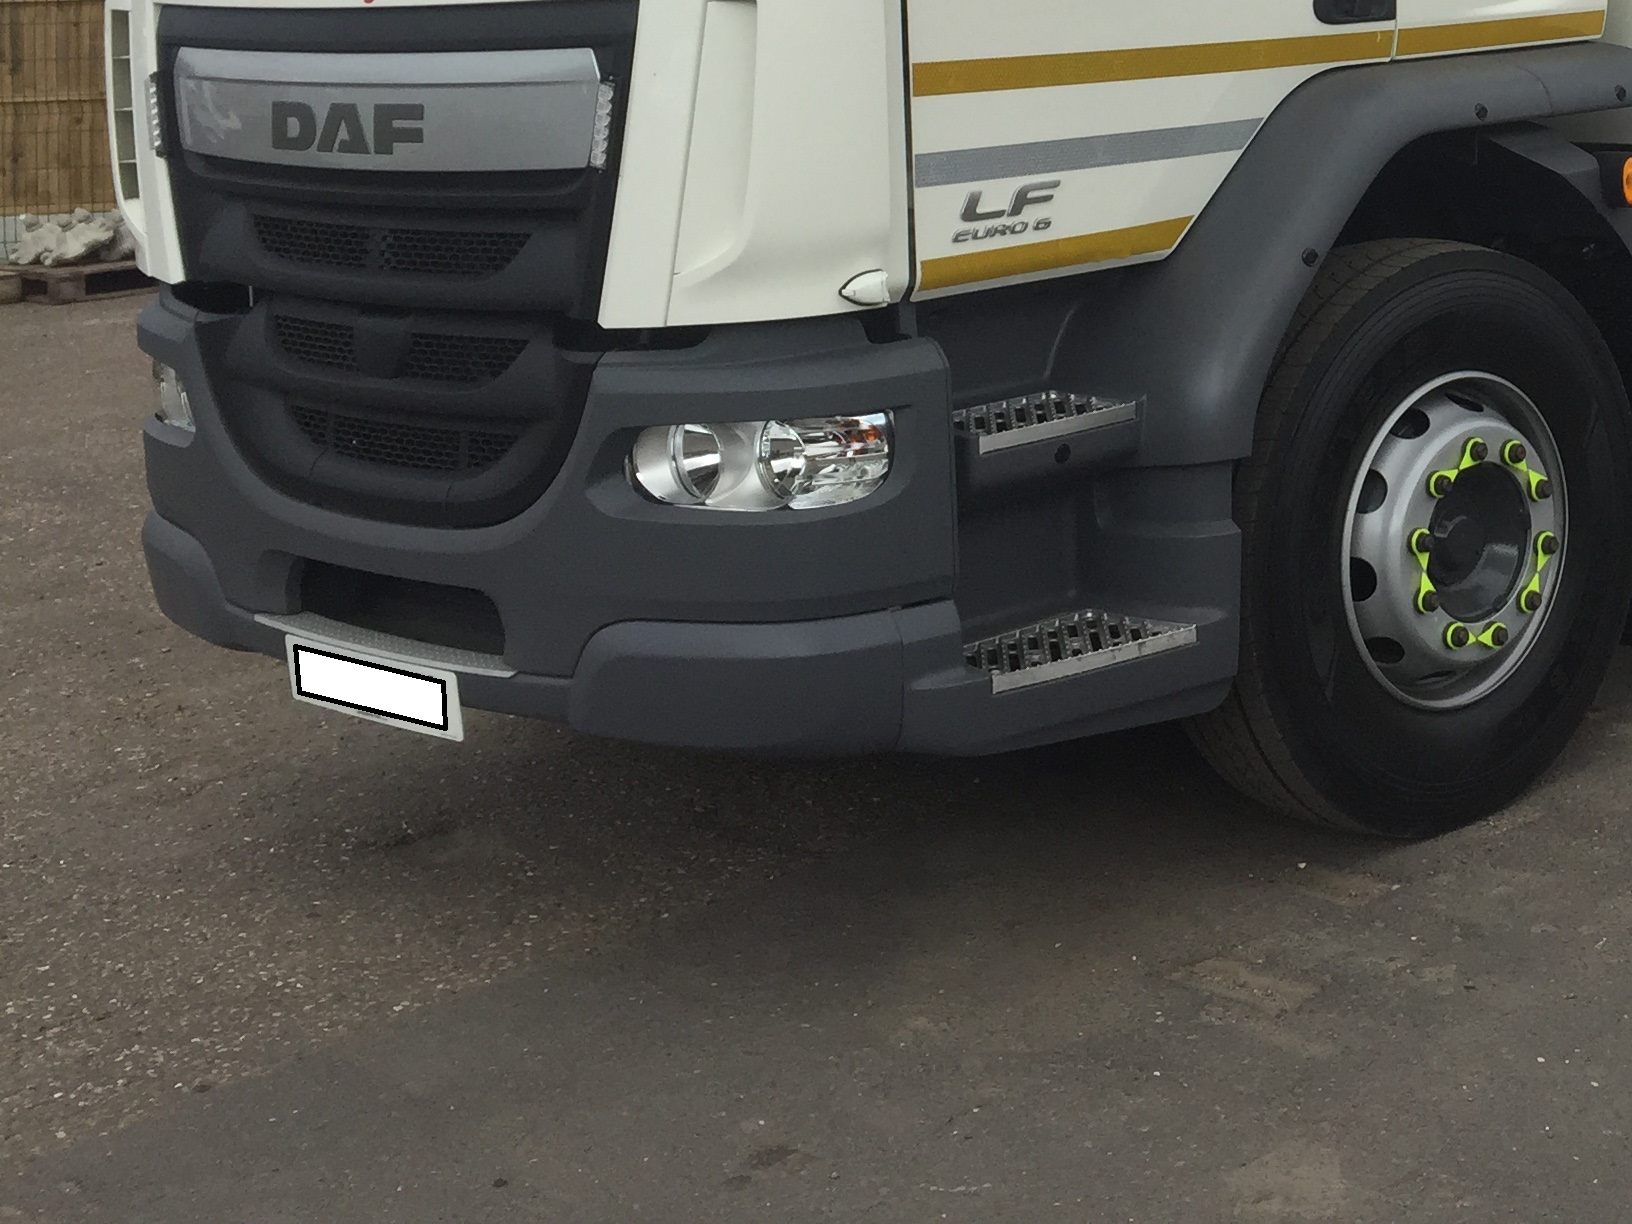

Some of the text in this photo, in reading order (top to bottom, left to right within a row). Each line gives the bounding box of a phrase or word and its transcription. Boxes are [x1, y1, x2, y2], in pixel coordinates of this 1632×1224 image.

[271, 100, 425, 155] DAF
[959, 179, 1061, 223] LF
[951, 216, 1053, 243] EURO 6
